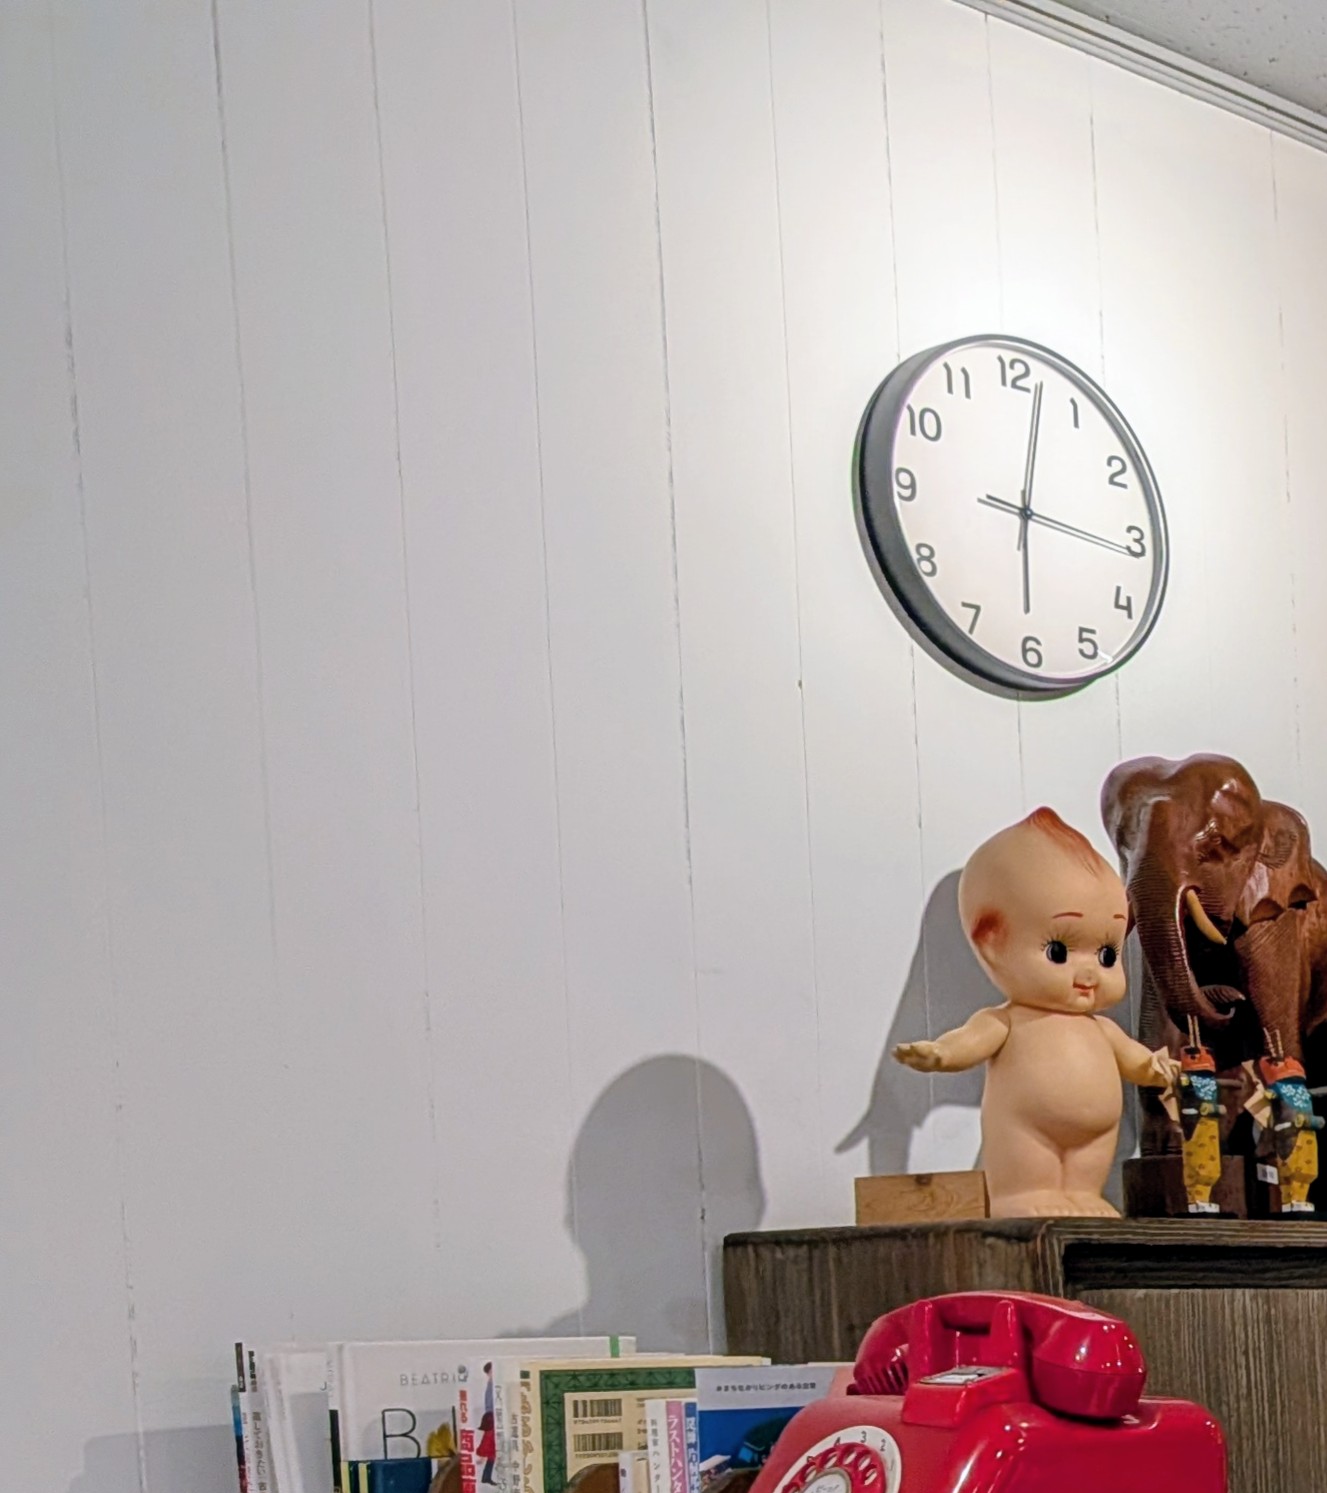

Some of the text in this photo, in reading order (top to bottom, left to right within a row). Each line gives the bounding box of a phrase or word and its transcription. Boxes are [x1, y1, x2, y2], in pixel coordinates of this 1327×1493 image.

[943, 362, 972, 400] 11
[997, 355, 1031, 393] 12
[906, 403, 942, 442] 10
[1069, 397, 1080, 429] 1
[895, 467, 917, 502] 9
[1106, 455, 1129, 489] 2
[1125, 525, 1147, 559] 3
[914, 543, 938, 578] 8
[961, 601, 982, 635] 7
[1114, 585, 1133, 620] 4
[1021, 636, 1043, 669] 6
[1077, 626, 1099, 660] 5
[400, 1372, 468, 1387] BEATRI
